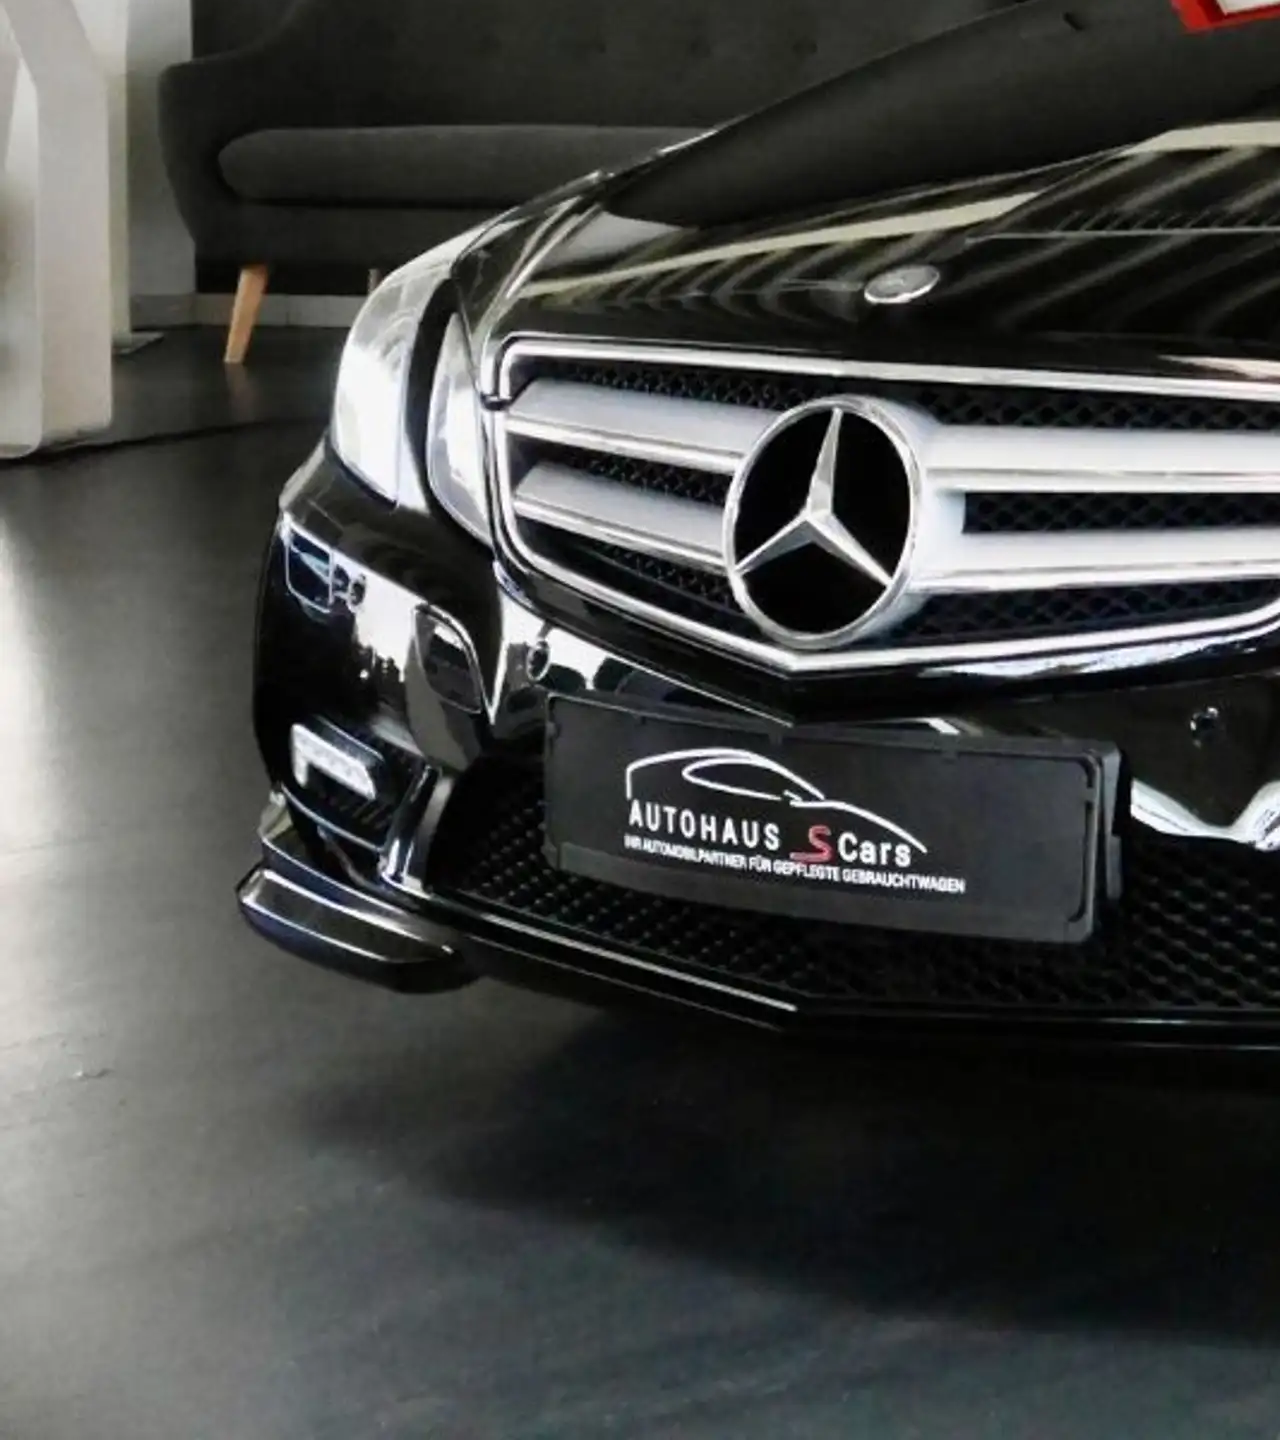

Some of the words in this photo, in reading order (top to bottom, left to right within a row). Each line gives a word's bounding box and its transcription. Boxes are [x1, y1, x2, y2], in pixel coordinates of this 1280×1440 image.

[629, 798, 781, 852] AUTOHAUS
[789, 824, 831, 862] S
[836, 831, 911, 868] Cars
[748, 853, 772, 873] FÜR
[773, 859, 841, 883] GEPFLEGTE
[841, 867, 967, 895] GEBRAUCHTWAGEN
